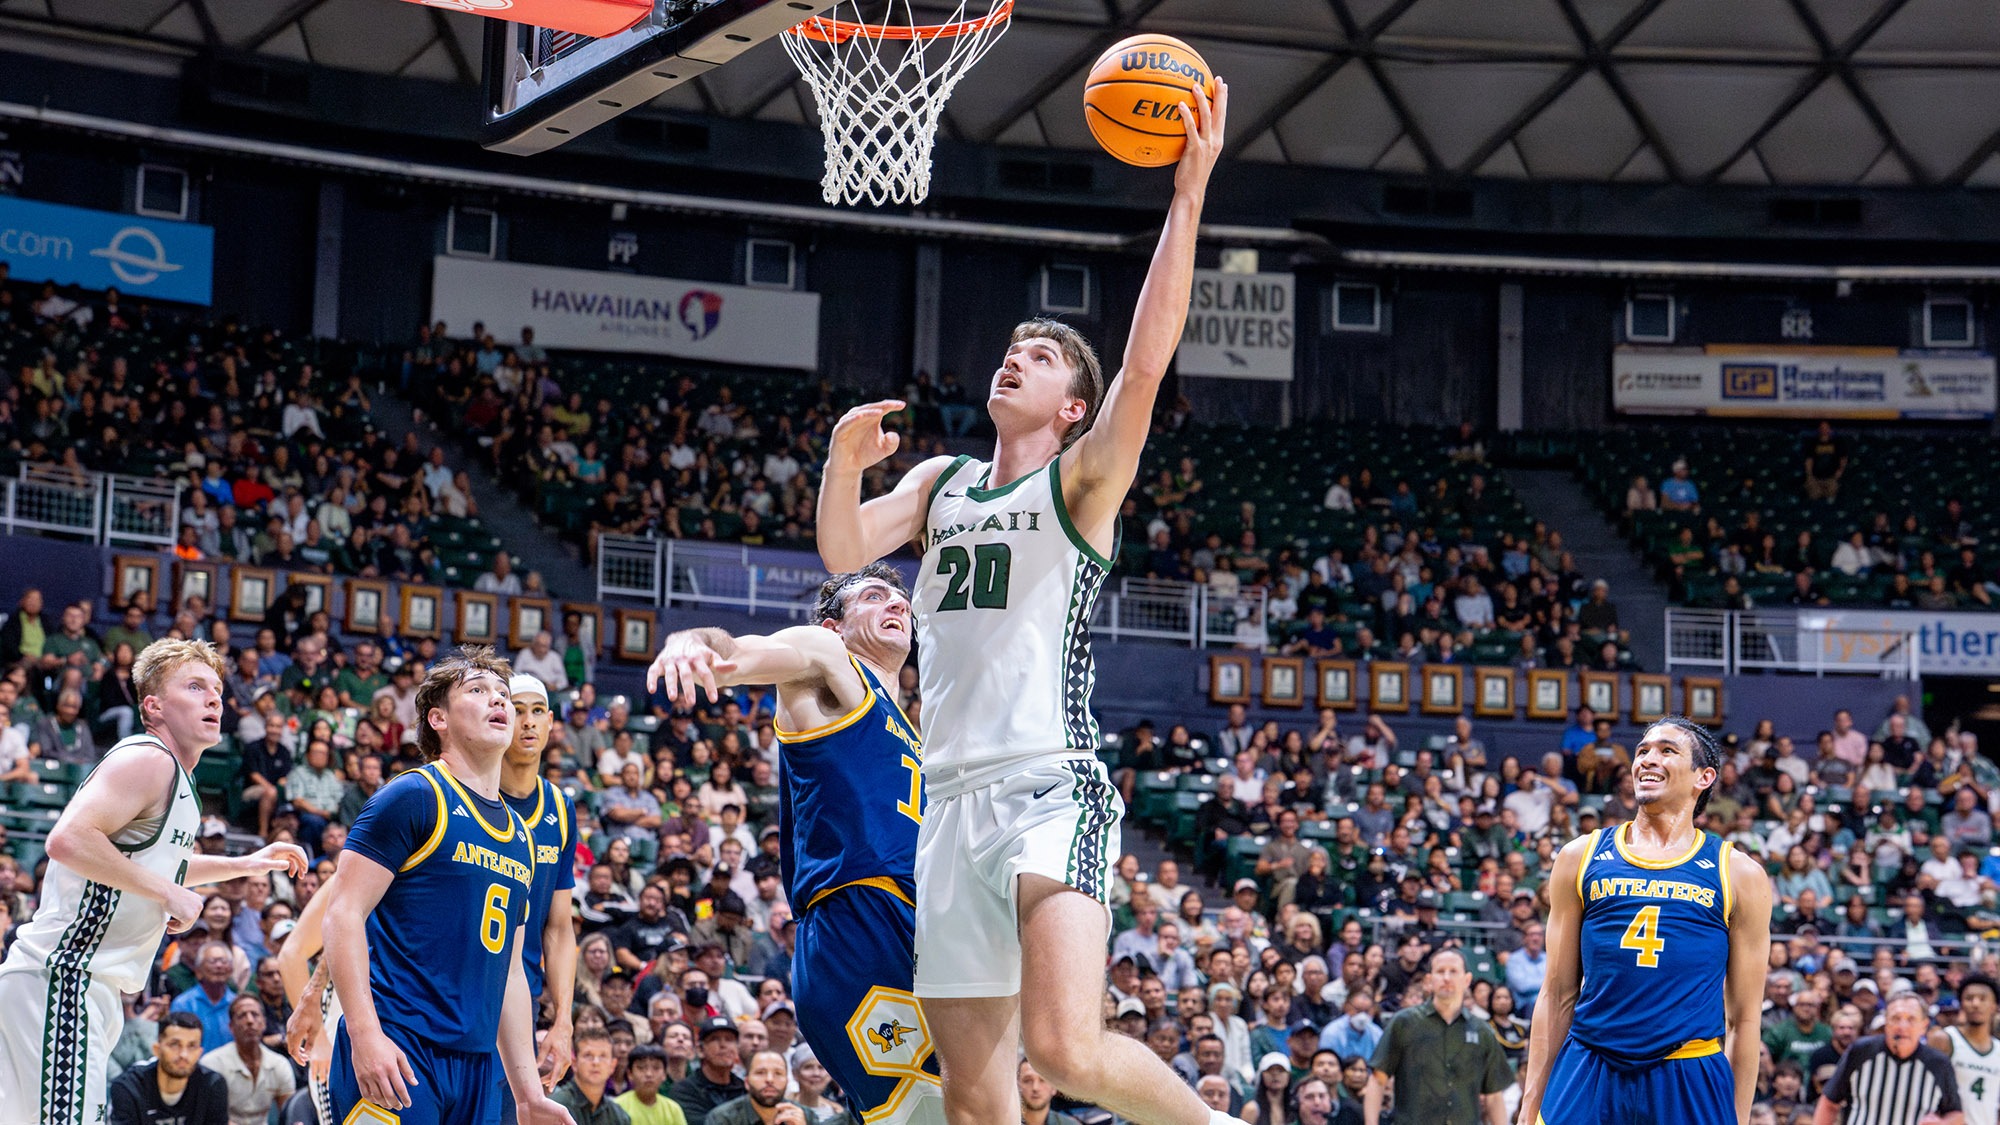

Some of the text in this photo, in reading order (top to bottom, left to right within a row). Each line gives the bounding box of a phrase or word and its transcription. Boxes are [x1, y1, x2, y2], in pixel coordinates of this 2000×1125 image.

[1121, 51, 1205, 87] Wilson
[532, 288, 671, 321] HAWAIIAN
[1190, 281, 1285, 313] ISLAND
[1183, 314, 1292, 349] MOVERS
[1781, 313, 1813, 338] RR
[1731, 373, 1767, 392] GP
[936, 543, 1011, 612] 20
[1590, 878, 1716, 908] ANTEATERS
[480, 883, 511, 954] 6
[1620, 906, 1665, 968] 4
[1971, 1077, 1984, 1101] 4
